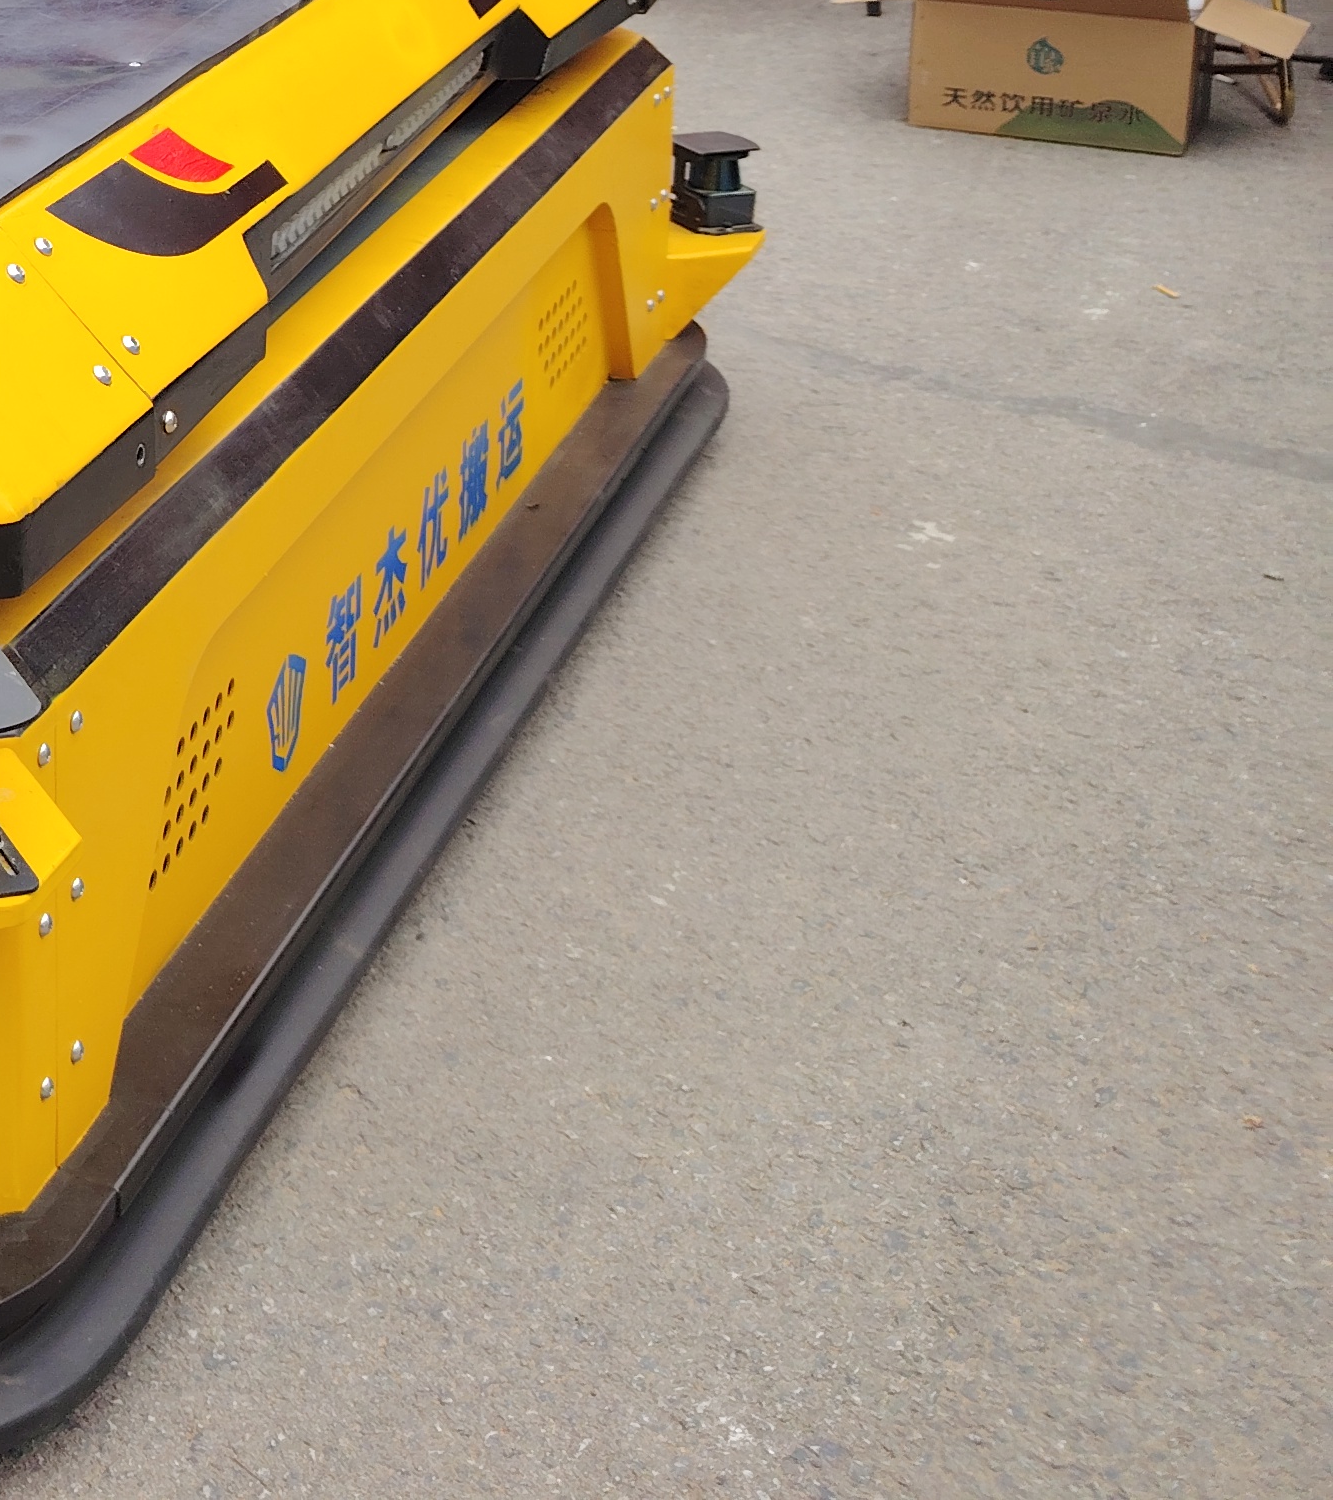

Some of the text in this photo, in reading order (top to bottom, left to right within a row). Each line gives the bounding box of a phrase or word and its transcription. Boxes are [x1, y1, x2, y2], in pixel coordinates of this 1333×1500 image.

[942, 85, 1146, 126] 天然饮用矿泉水
[325, 377, 526, 705] 智杰优搬运
